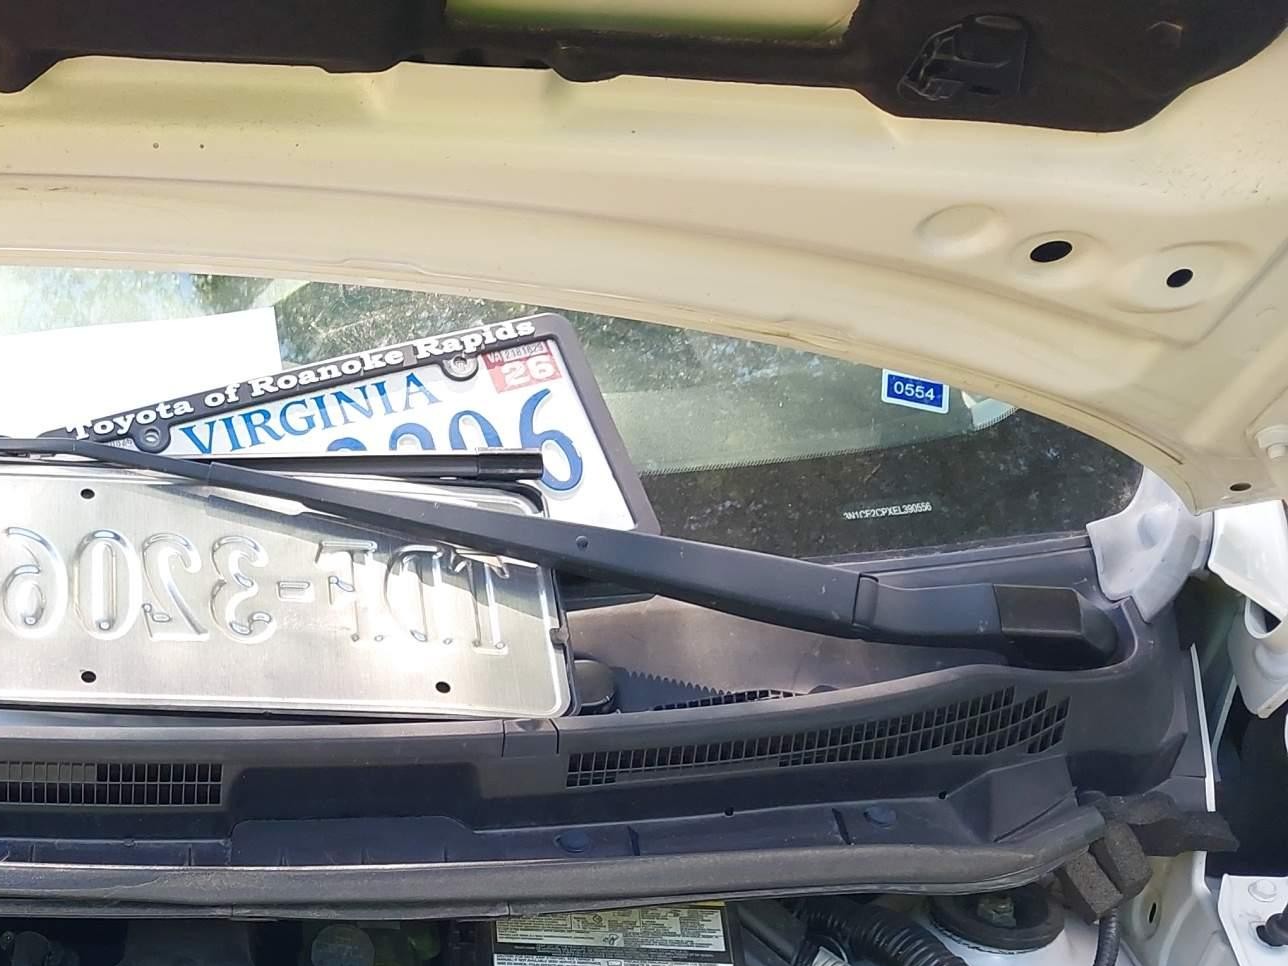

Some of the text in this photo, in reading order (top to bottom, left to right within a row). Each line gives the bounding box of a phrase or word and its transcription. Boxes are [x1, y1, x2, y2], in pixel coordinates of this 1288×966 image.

[487, 351, 502, 364] VA
[503, 357, 556, 386] 26
[66, 319, 536, 440] Toyota of Roanoke Rapids
[893, 381, 936, 401] 0554
[178, 372, 443, 456] VIRGINIA
